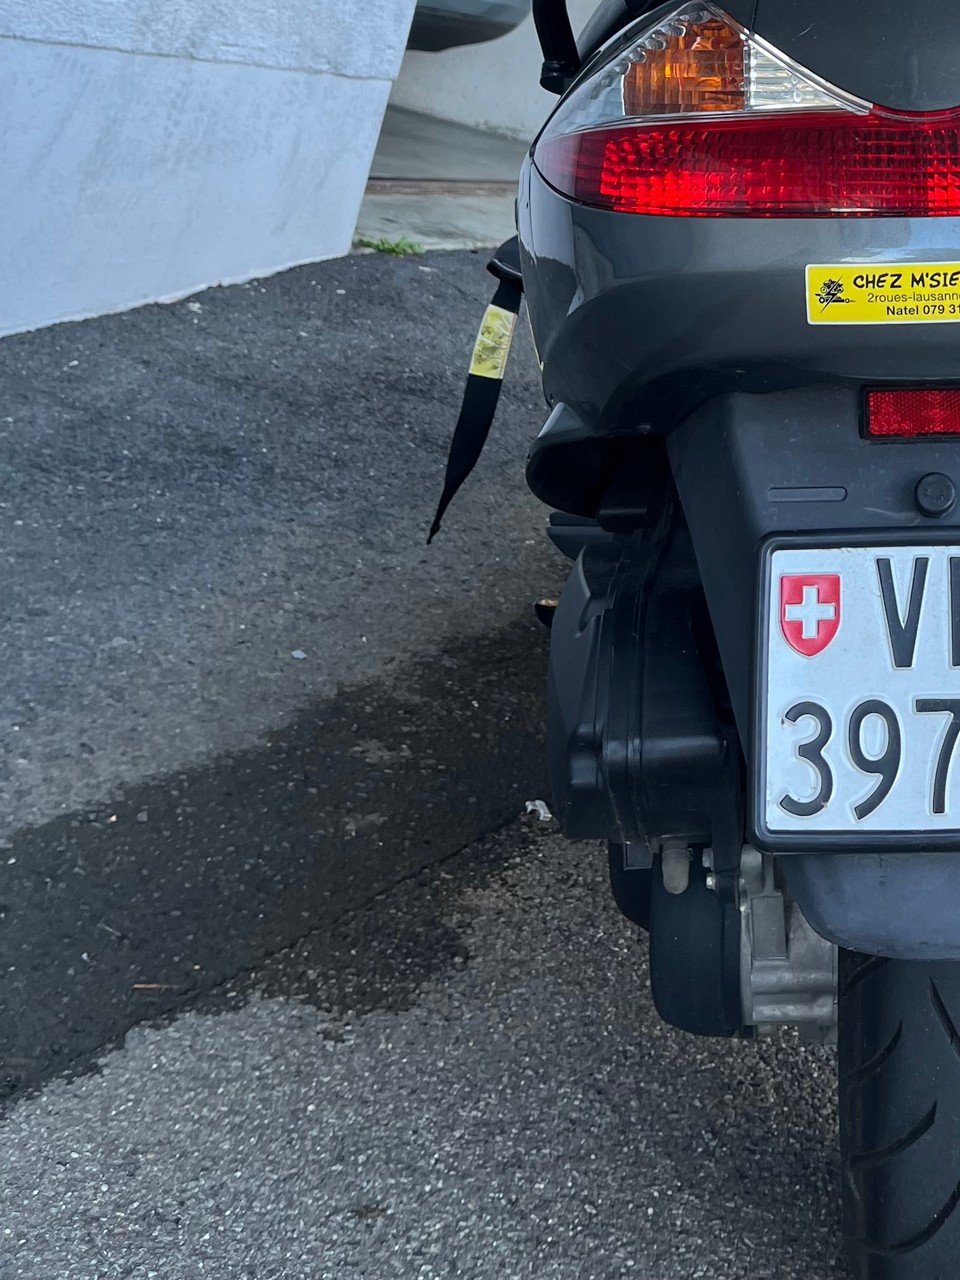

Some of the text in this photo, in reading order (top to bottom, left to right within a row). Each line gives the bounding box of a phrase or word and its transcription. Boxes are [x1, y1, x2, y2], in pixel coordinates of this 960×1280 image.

[852, 273, 903, 289] CHEZ
[886, 305, 920, 316] Natel
[922, 304, 946, 315] 079
